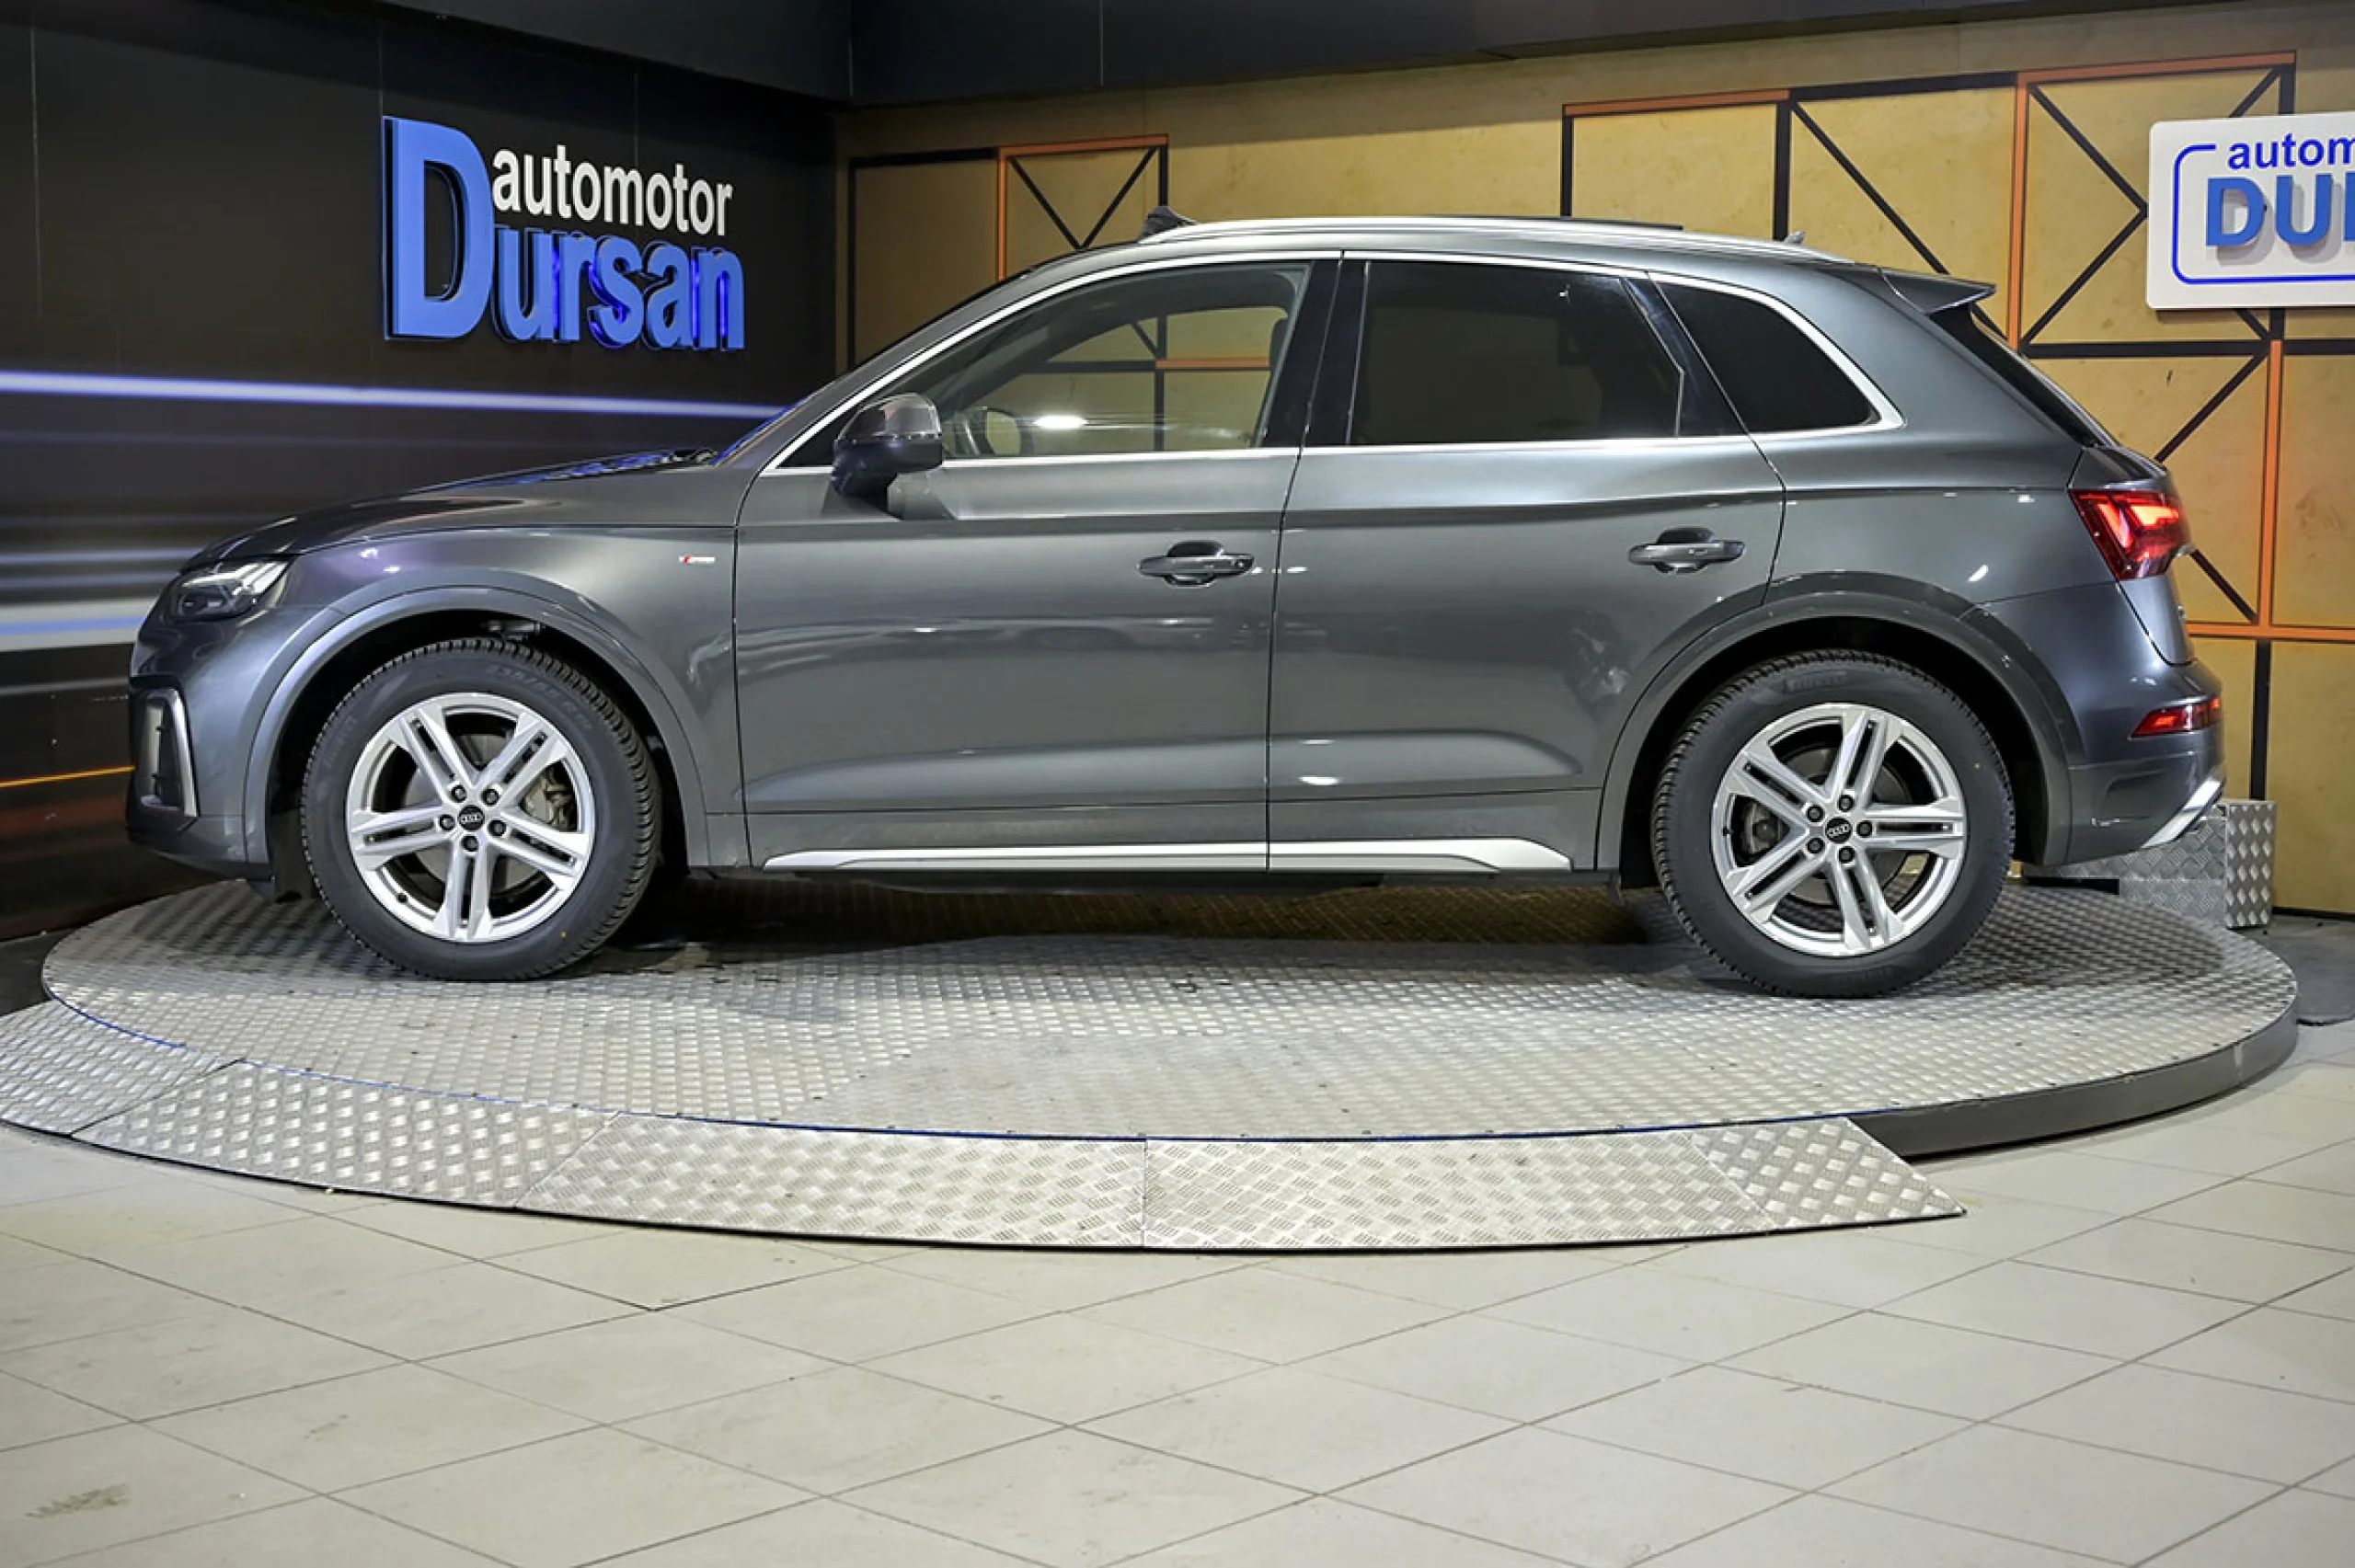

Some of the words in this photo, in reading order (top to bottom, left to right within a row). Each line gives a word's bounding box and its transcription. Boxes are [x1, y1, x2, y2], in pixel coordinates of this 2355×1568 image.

[382, 115, 745, 351] Dursan
[492, 144, 733, 235] automotor
[2205, 172, 2355, 246] DU
